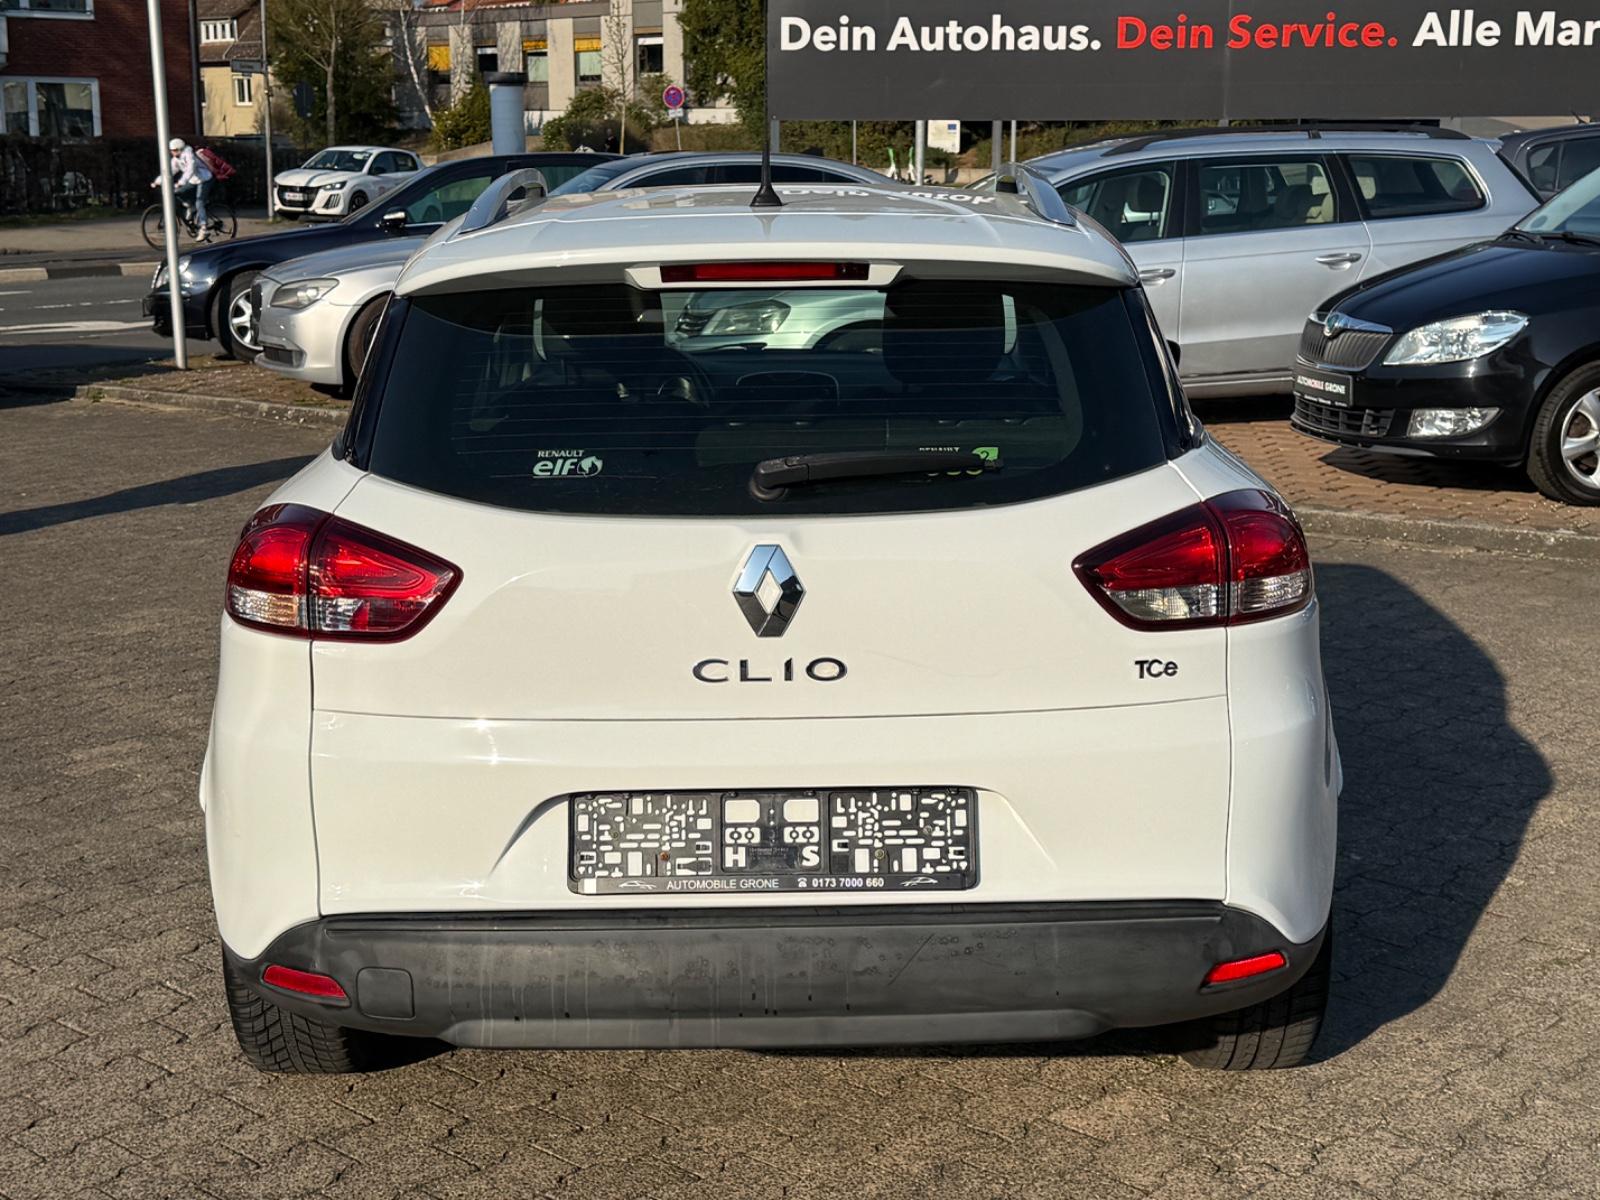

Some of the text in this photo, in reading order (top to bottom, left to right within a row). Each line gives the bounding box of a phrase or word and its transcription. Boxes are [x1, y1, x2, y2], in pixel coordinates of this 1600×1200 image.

[780, 9, 1600, 52] Dein Autohaus. Dein Service. Alle Mar
[537, 449, 585, 458] RENAULT
[532, 458, 578, 476] elf
[691, 657, 848, 685] CLIO
[1133, 658, 1179, 680] TCe
[666, 877, 885, 890] AUTOMOBILE GRONE 0173 7000 660
